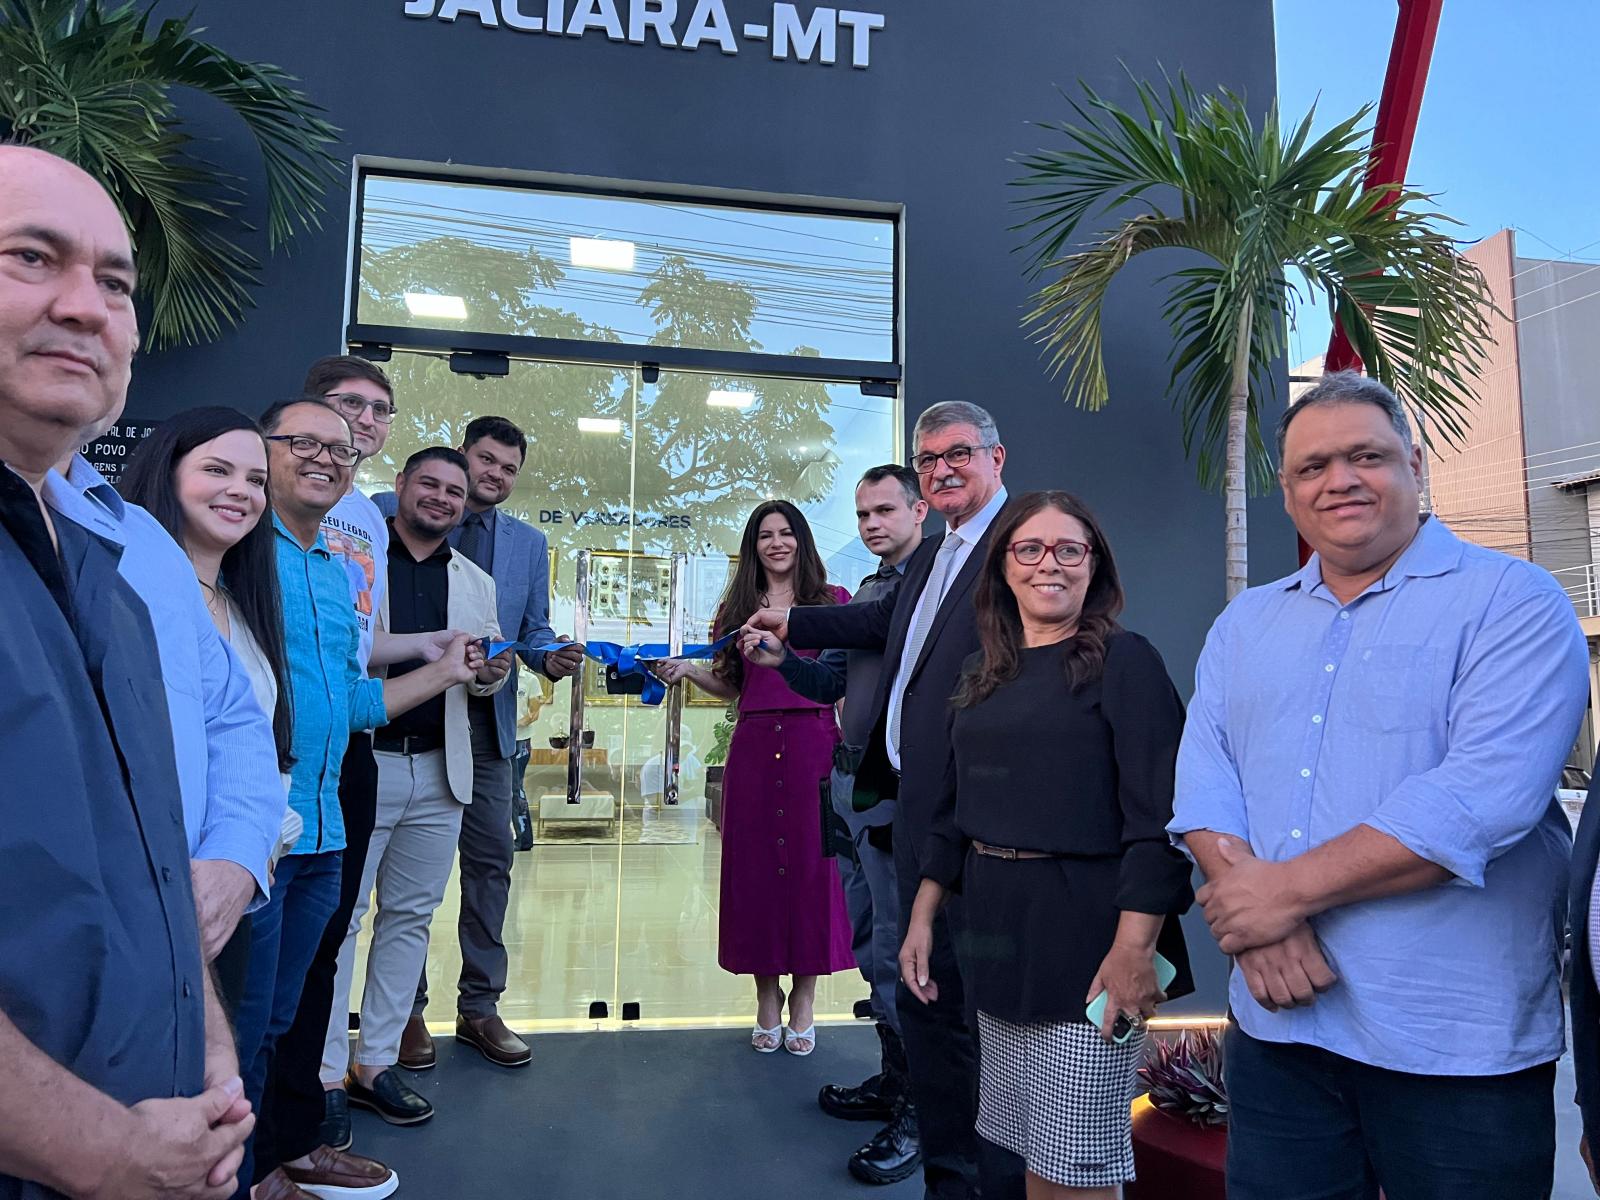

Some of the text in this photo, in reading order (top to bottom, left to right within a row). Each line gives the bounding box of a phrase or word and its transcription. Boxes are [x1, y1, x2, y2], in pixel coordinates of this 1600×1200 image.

[125, 426, 137, 439] DE
[141, 427, 155, 439] JO
[95, 443, 126, 456] POVO
[90, 462, 117, 472] GENS
[321, 515, 340, 528] SEU
[539, 509, 563, 524] DE
